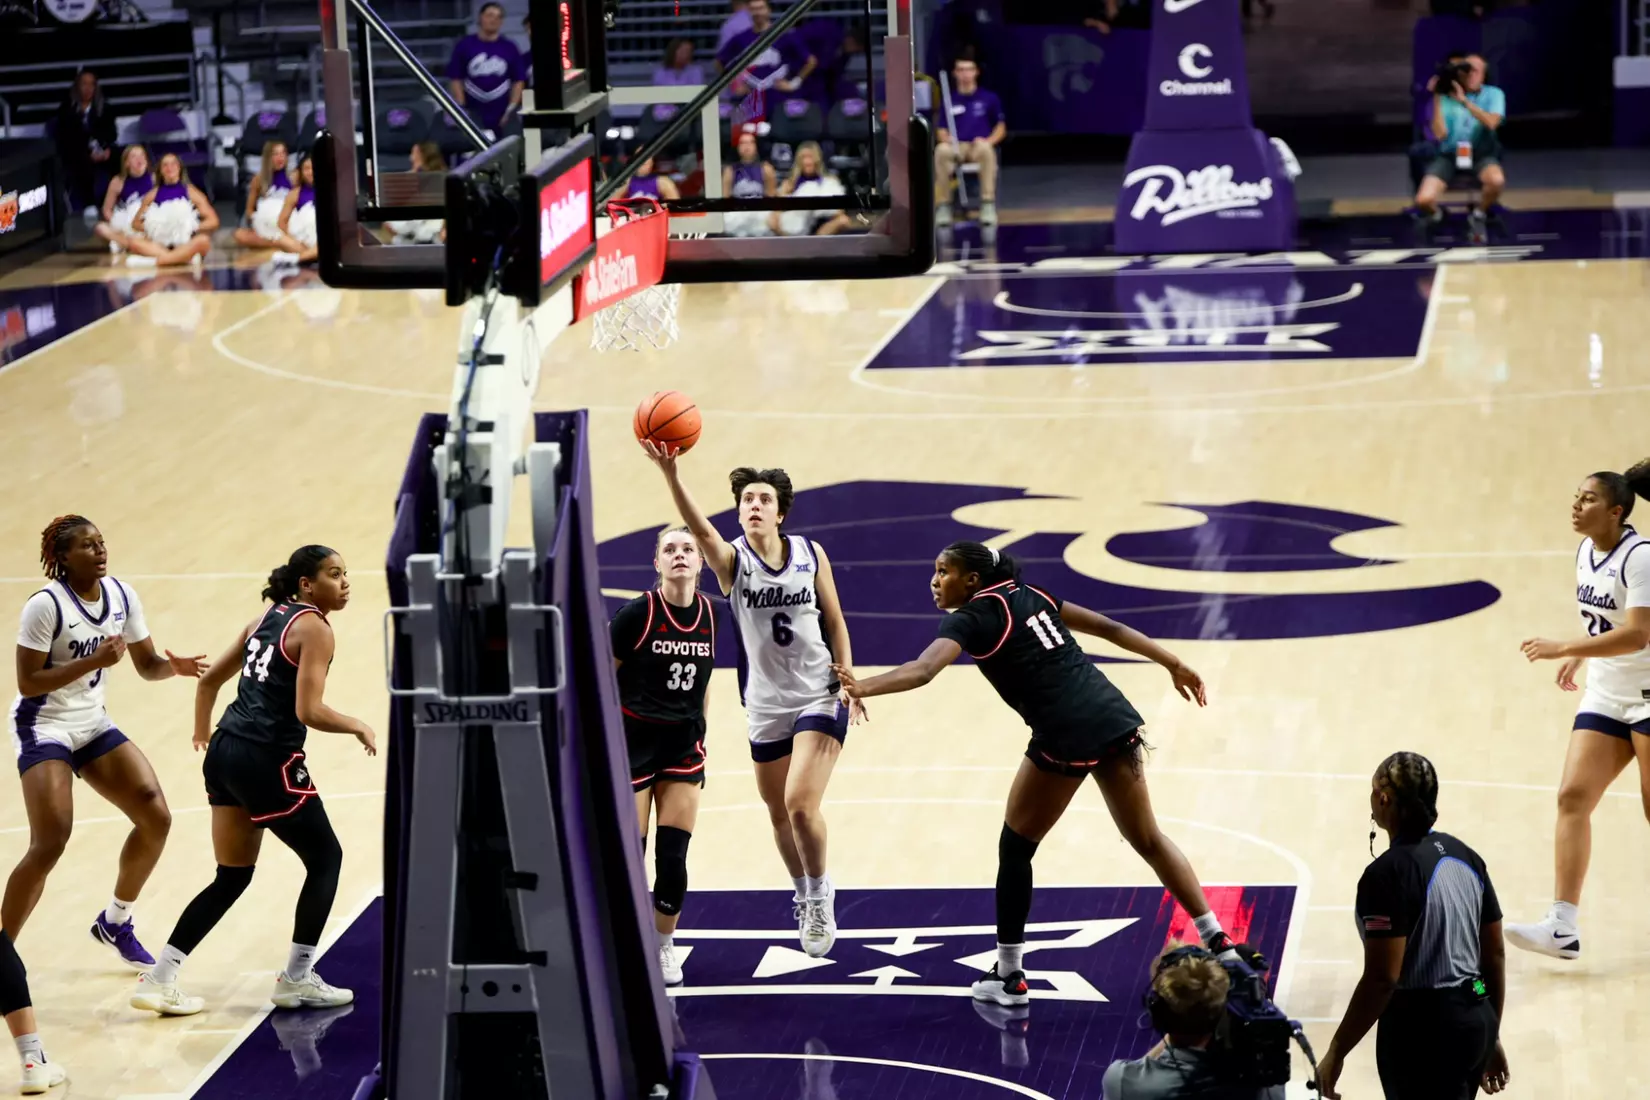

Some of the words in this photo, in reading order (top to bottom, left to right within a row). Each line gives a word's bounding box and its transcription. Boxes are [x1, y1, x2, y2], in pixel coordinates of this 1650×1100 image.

[1159, 79, 1231, 96] Channel
[1123, 165, 1273, 224] Dillons
[742, 586, 813, 608] Wildcats
[771, 612, 794, 647] 6
[1026, 610, 1065, 650] 11
[243, 637, 275, 682] 24
[652, 640, 710, 657] COYOTES
[667, 662, 697, 691] 33
[423, 701, 528, 723] SPALDING
